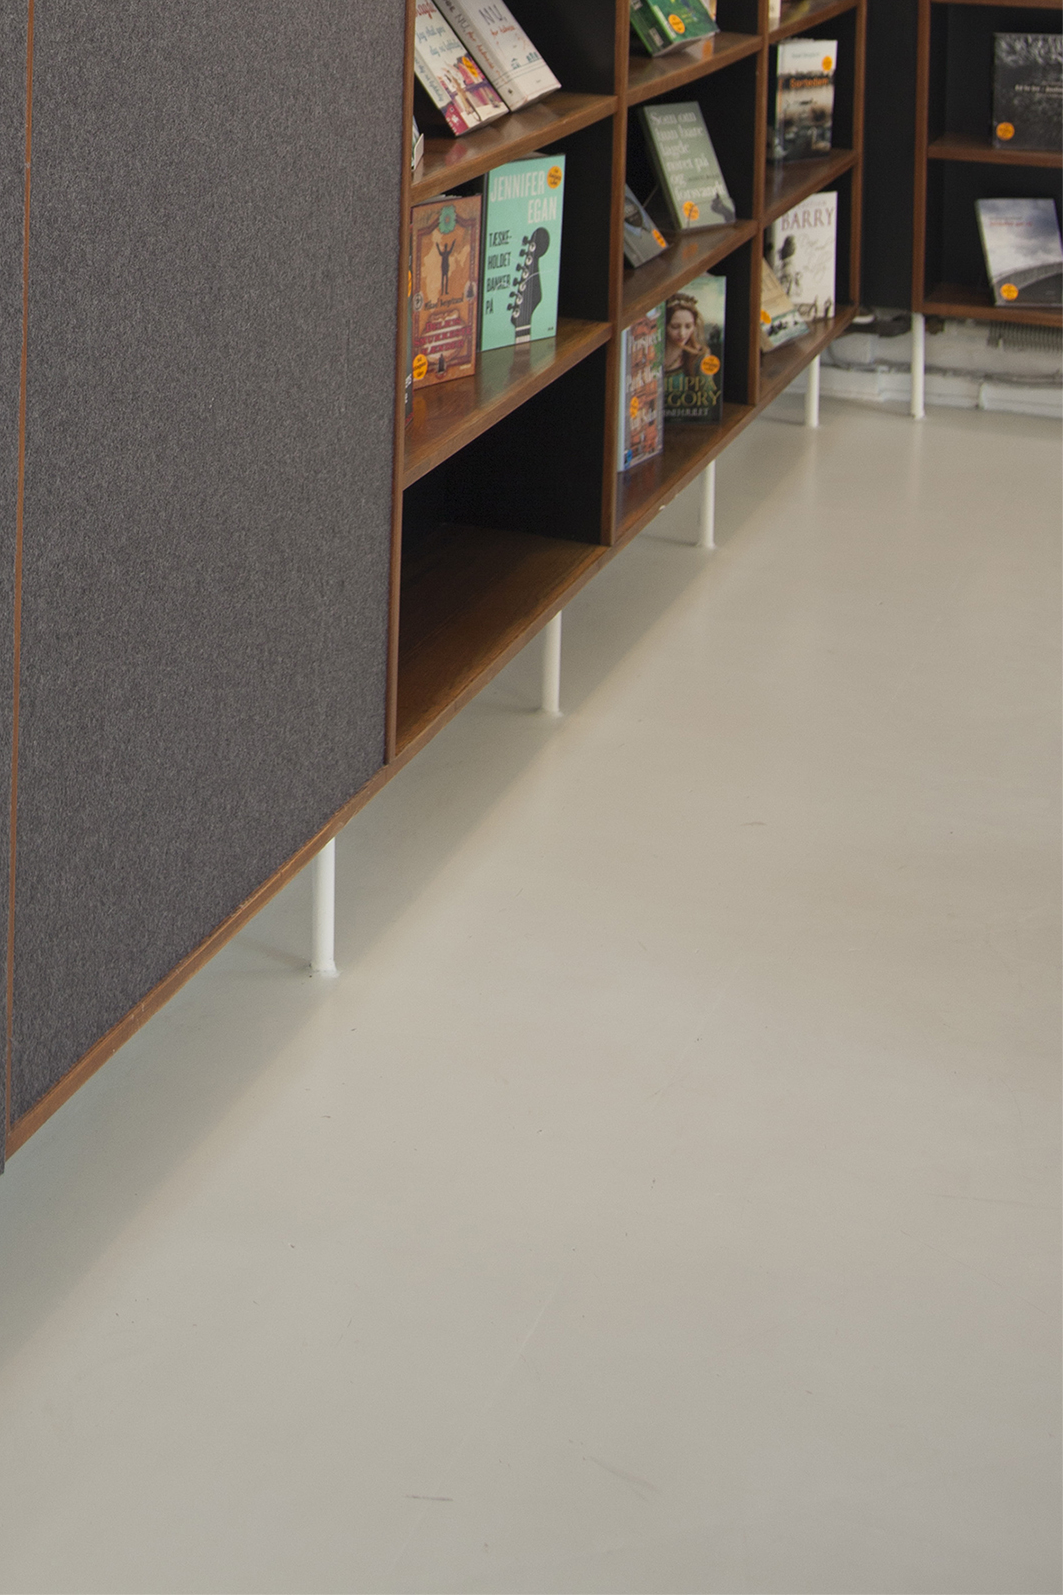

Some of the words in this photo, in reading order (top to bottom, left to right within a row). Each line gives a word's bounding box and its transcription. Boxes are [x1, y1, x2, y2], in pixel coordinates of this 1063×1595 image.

[490, 170, 545, 203] JENNIFER
[527, 195, 558, 224] EGAN
[781, 207, 834, 231] BARRY
[488, 230, 513, 248] TÆSKE-
[487, 251, 511, 271] HOLDET
[486, 273, 511, 293] BANKER
[664, 376, 717, 391] ILIPPA
[667, 391, 721, 406] GORY
